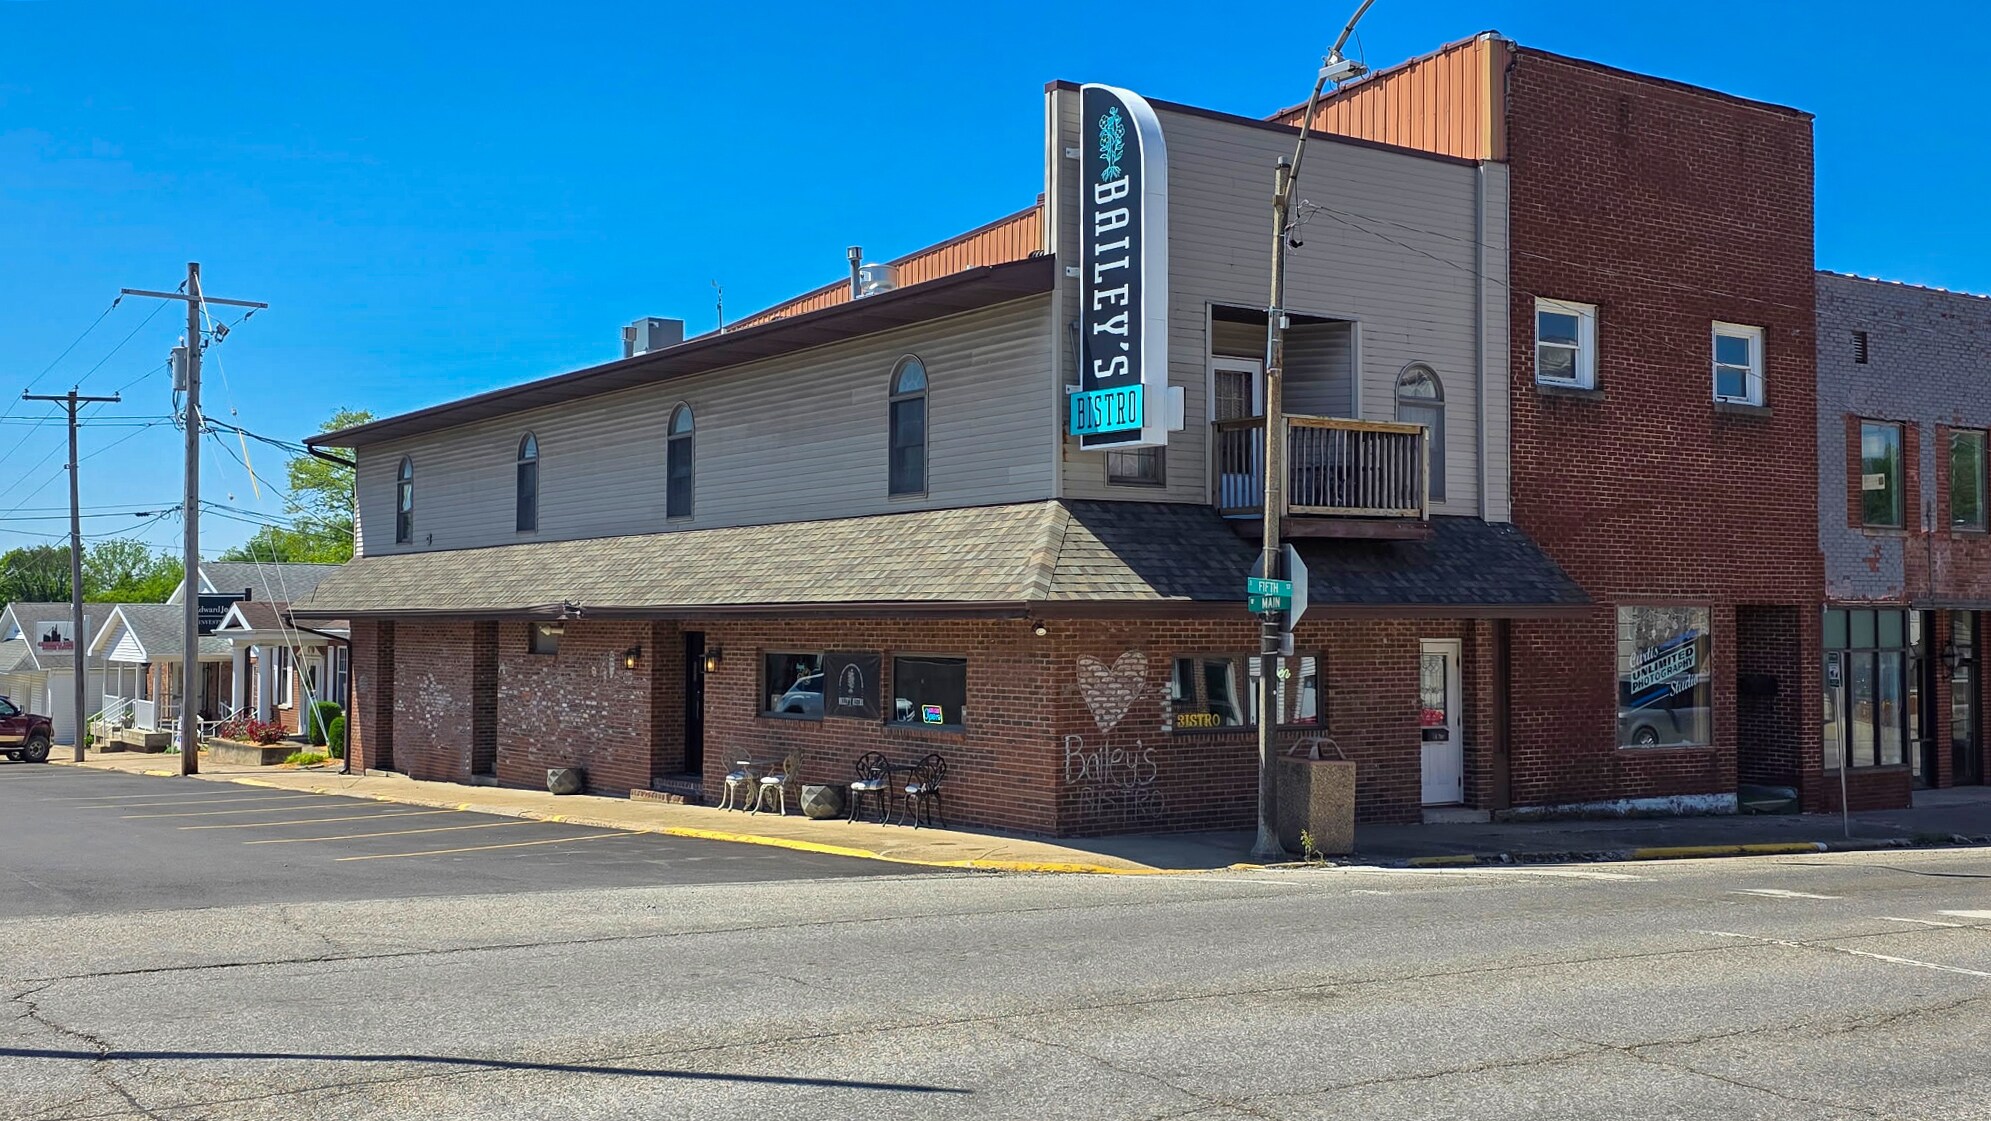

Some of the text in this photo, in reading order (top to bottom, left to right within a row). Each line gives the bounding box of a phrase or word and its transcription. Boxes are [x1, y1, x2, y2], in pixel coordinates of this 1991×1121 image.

[1093, 174, 1130, 378] BAILEY'S
[1076, 390, 1137, 430] BISTRO
[1258, 581, 1279, 594] FIFTH
[198, 605, 221, 613] dward
[1261, 596, 1281, 609] MAIN
[1629, 646, 1659, 668] Curtis
[1632, 647, 1694, 681] UNLIMITED
[1632, 656, 1695, 692] PHOTOGRAPHY
[1669, 674, 1699, 697] Studio
[1065, 735, 1158, 788] Bailey's
